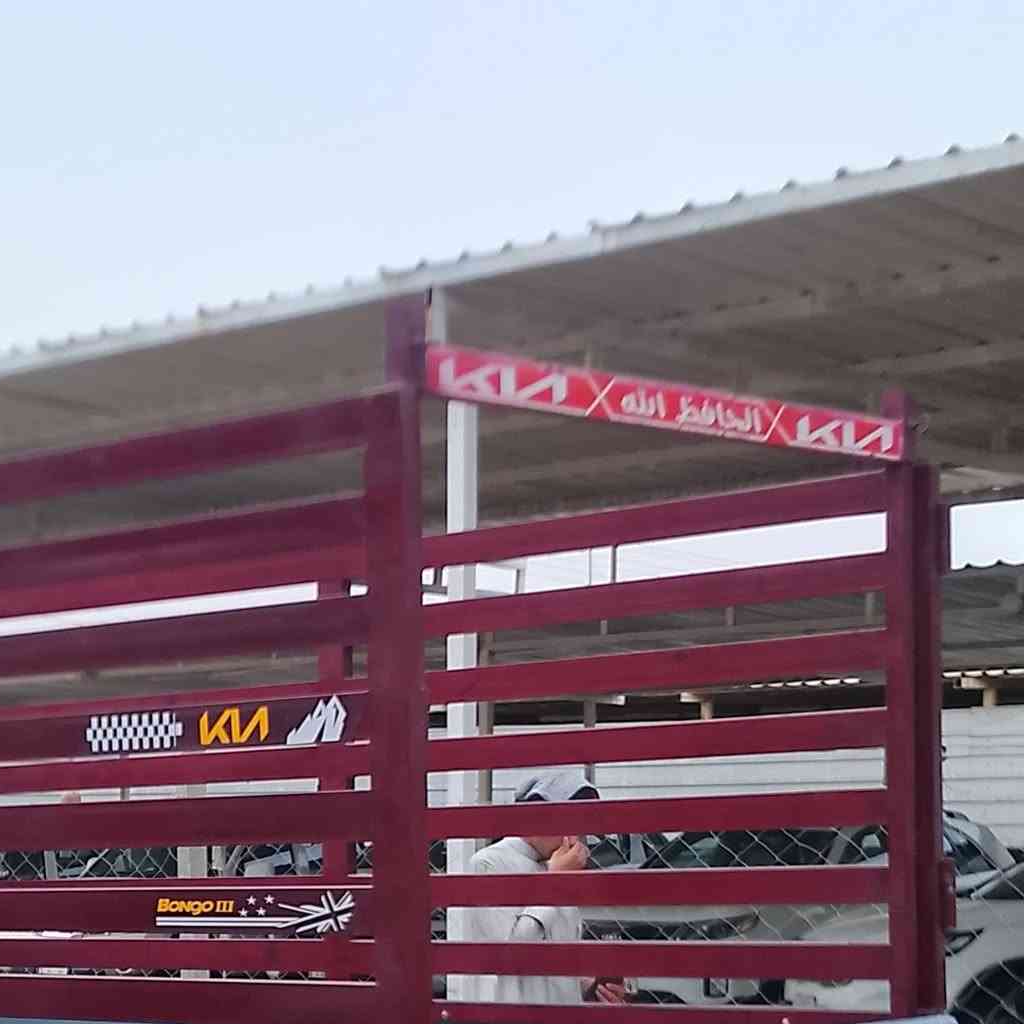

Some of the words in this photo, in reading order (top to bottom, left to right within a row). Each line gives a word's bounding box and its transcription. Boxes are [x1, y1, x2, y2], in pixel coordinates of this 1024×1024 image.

[439, 358, 568, 405] KIA
[621, 388, 667, 418] الله
[795, 415, 894, 453] KIA
[198, 706, 269, 746] KIA
[215, 900, 234, 913] III
